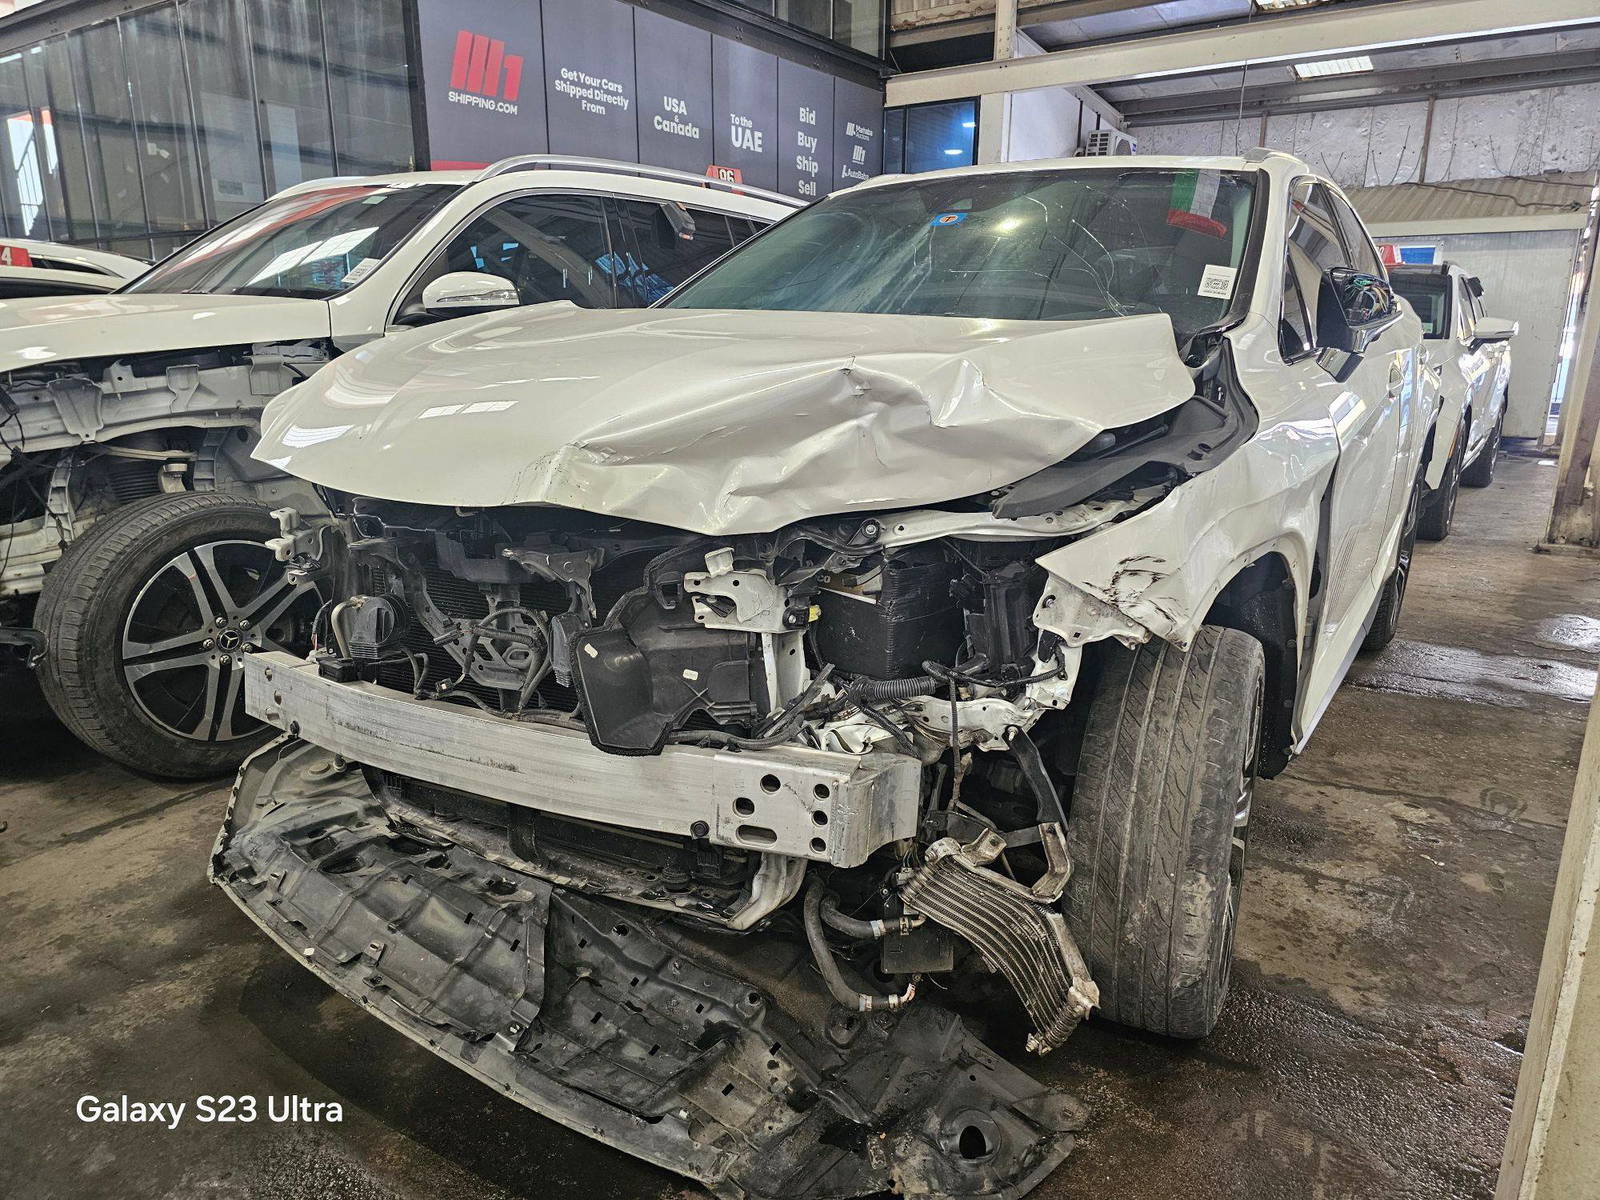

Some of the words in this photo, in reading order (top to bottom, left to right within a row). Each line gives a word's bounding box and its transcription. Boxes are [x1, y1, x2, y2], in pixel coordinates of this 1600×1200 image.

[560, 68, 578, 82] Get
[578, 71, 601, 88] Your
[601, 77, 623, 93] Cars
[448, 91, 518, 115] SHIPPING.COM
[555, 79, 594, 99] Shipped
[594, 89, 629, 111] Directly
[663, 95, 687, 115] USA
[581, 100, 606, 115] From
[674, 114, 680, 123] &
[799, 106, 816, 126] Bid
[653, 115, 700, 139] Canada
[730, 113, 740, 125] To
[740, 115, 753, 128] the
[730, 125, 763, 153] UAE
[797, 131, 818, 154] Buy
[796, 155, 819, 178] Ship
[798, 179, 816, 196] Sell
